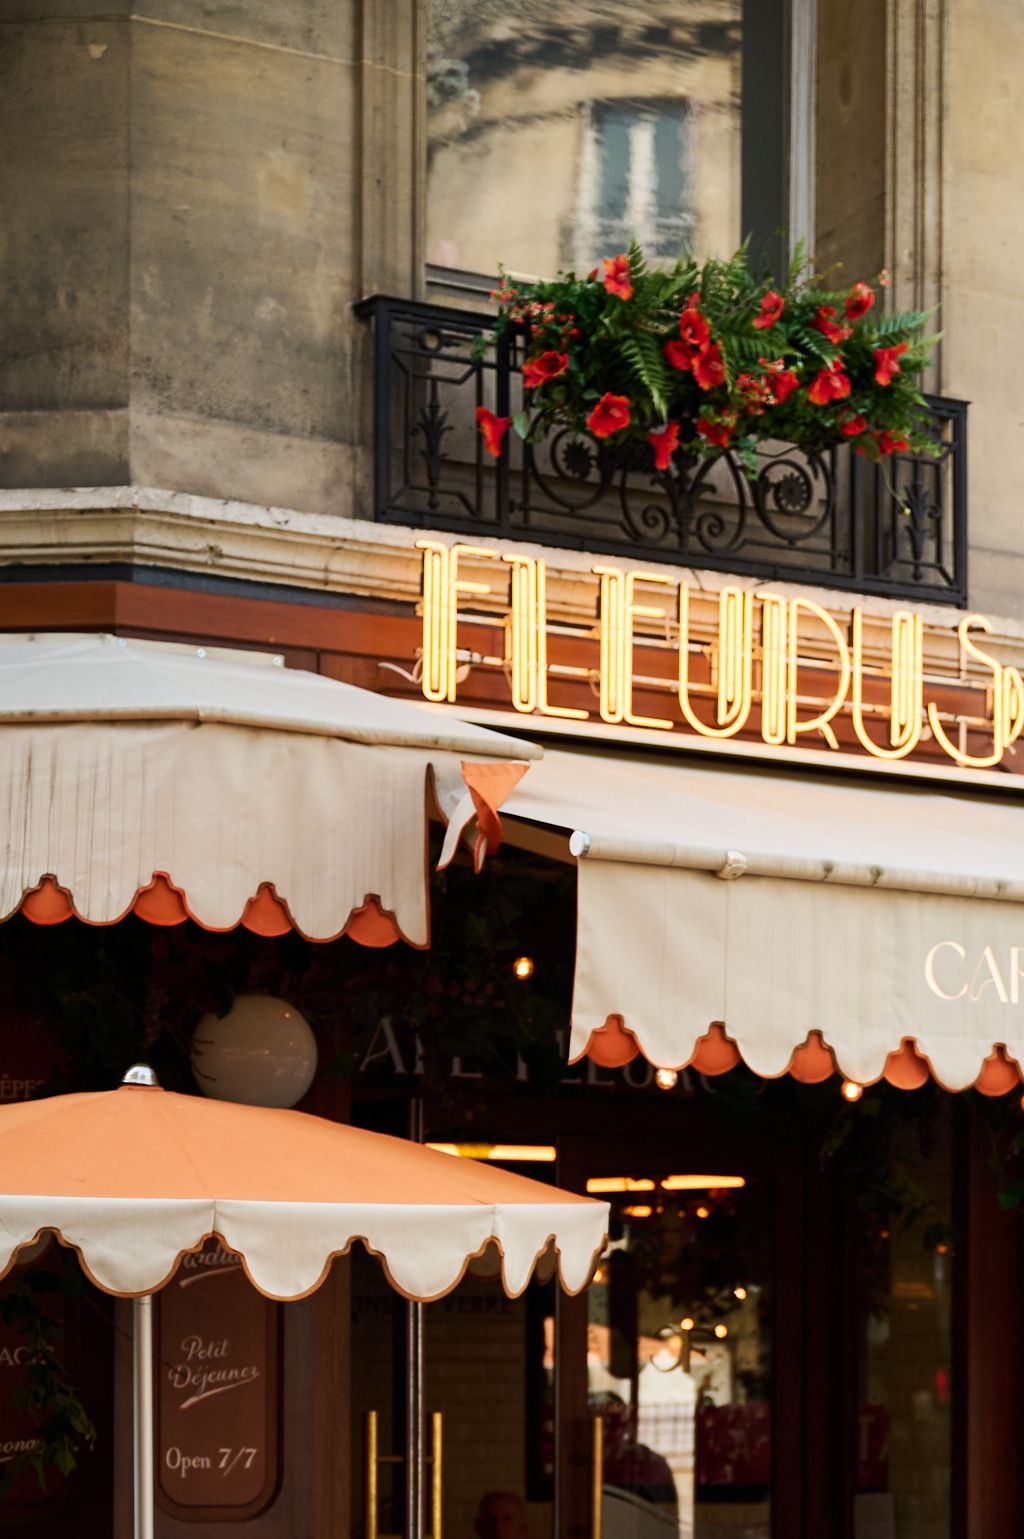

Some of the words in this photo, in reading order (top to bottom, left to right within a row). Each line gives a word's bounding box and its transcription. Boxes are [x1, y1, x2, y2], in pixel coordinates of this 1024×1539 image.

[181, 1335, 231, 1361] Petit
[168, 1363, 261, 1396] Déjeuner
[166, 1446, 210, 1479] Open
[218, 1446, 258, 1477] 7/7
